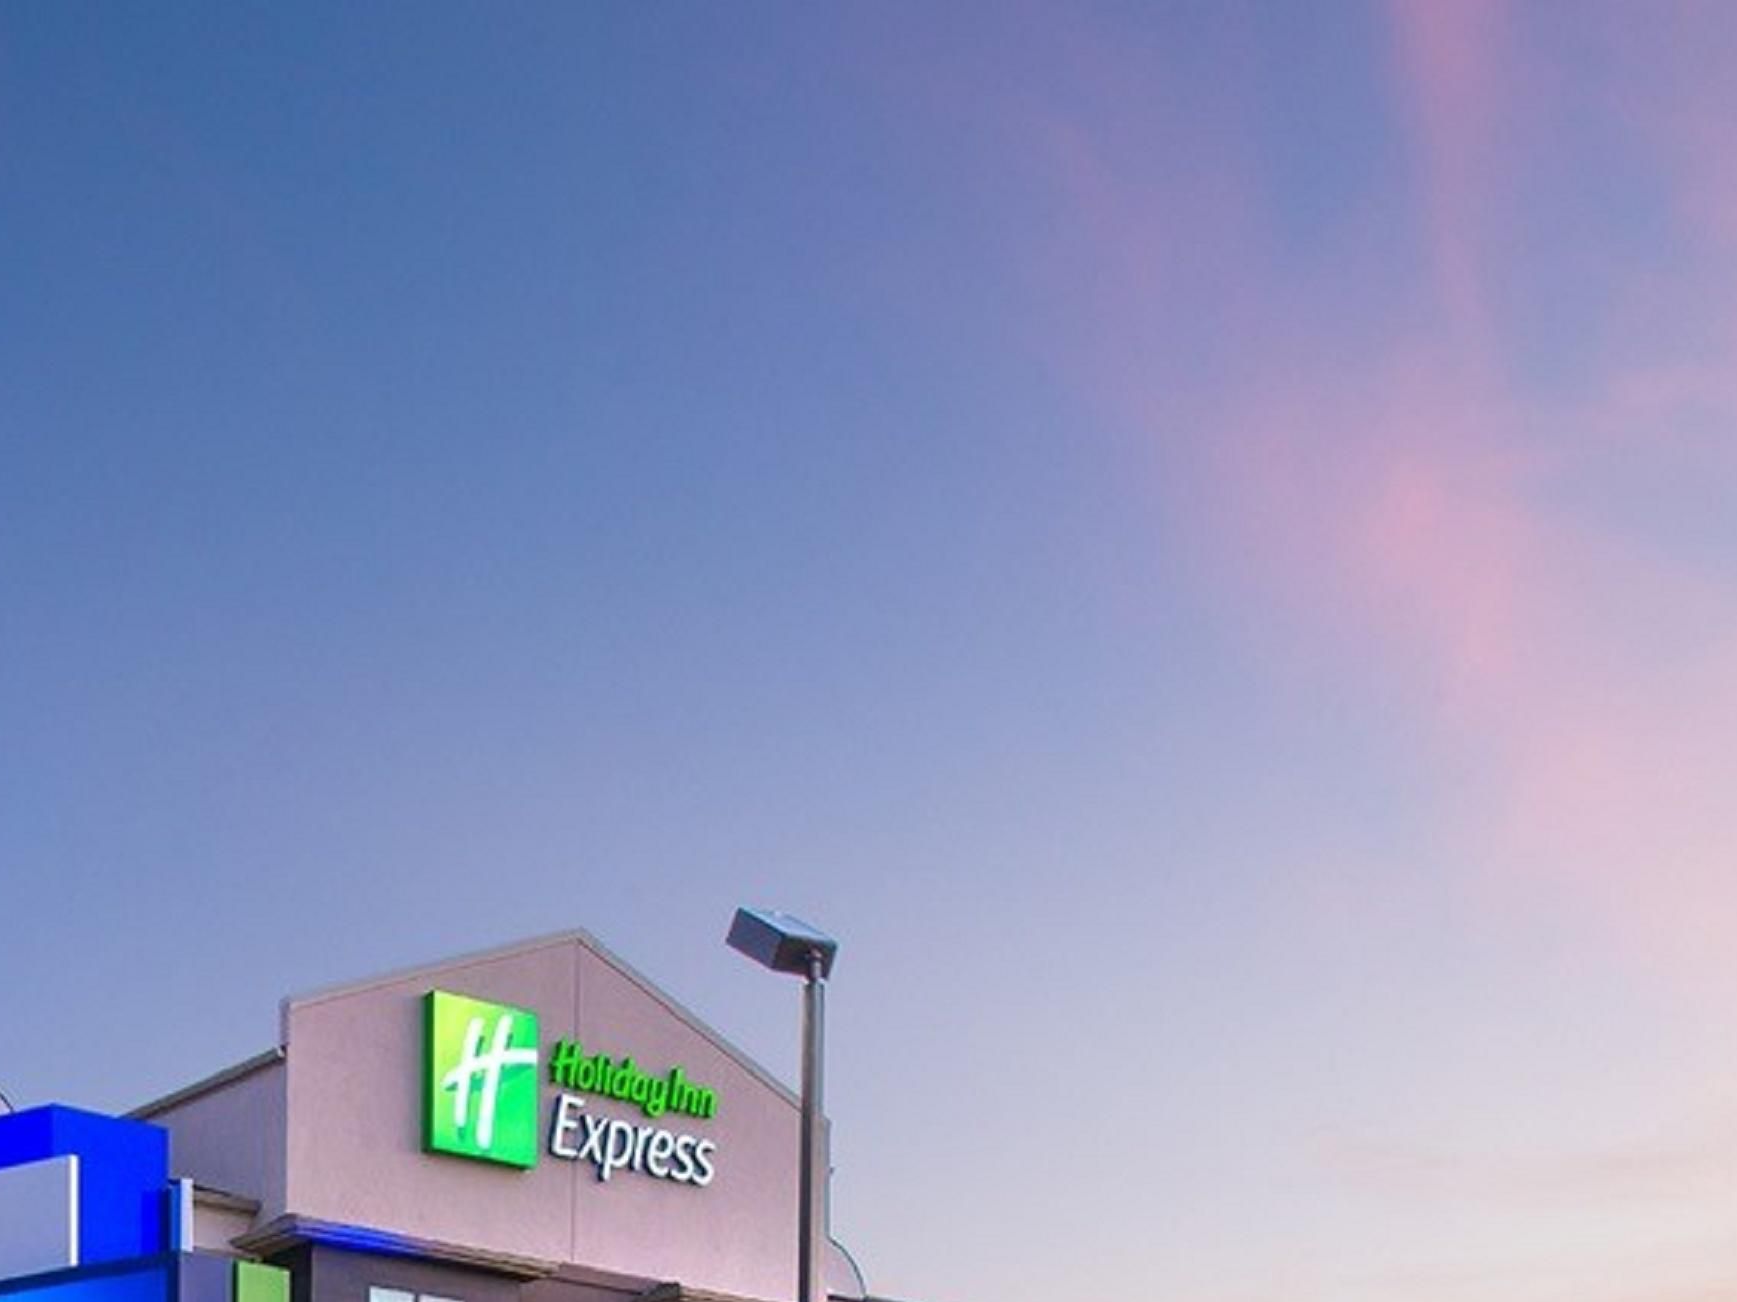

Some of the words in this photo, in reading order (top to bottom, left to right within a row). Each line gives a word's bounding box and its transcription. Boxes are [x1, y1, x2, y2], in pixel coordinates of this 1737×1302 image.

[549, 1039, 665, 1118] Holiday
[666, 1065, 718, 1118] Inn
[549, 1093, 716, 1187] Express
